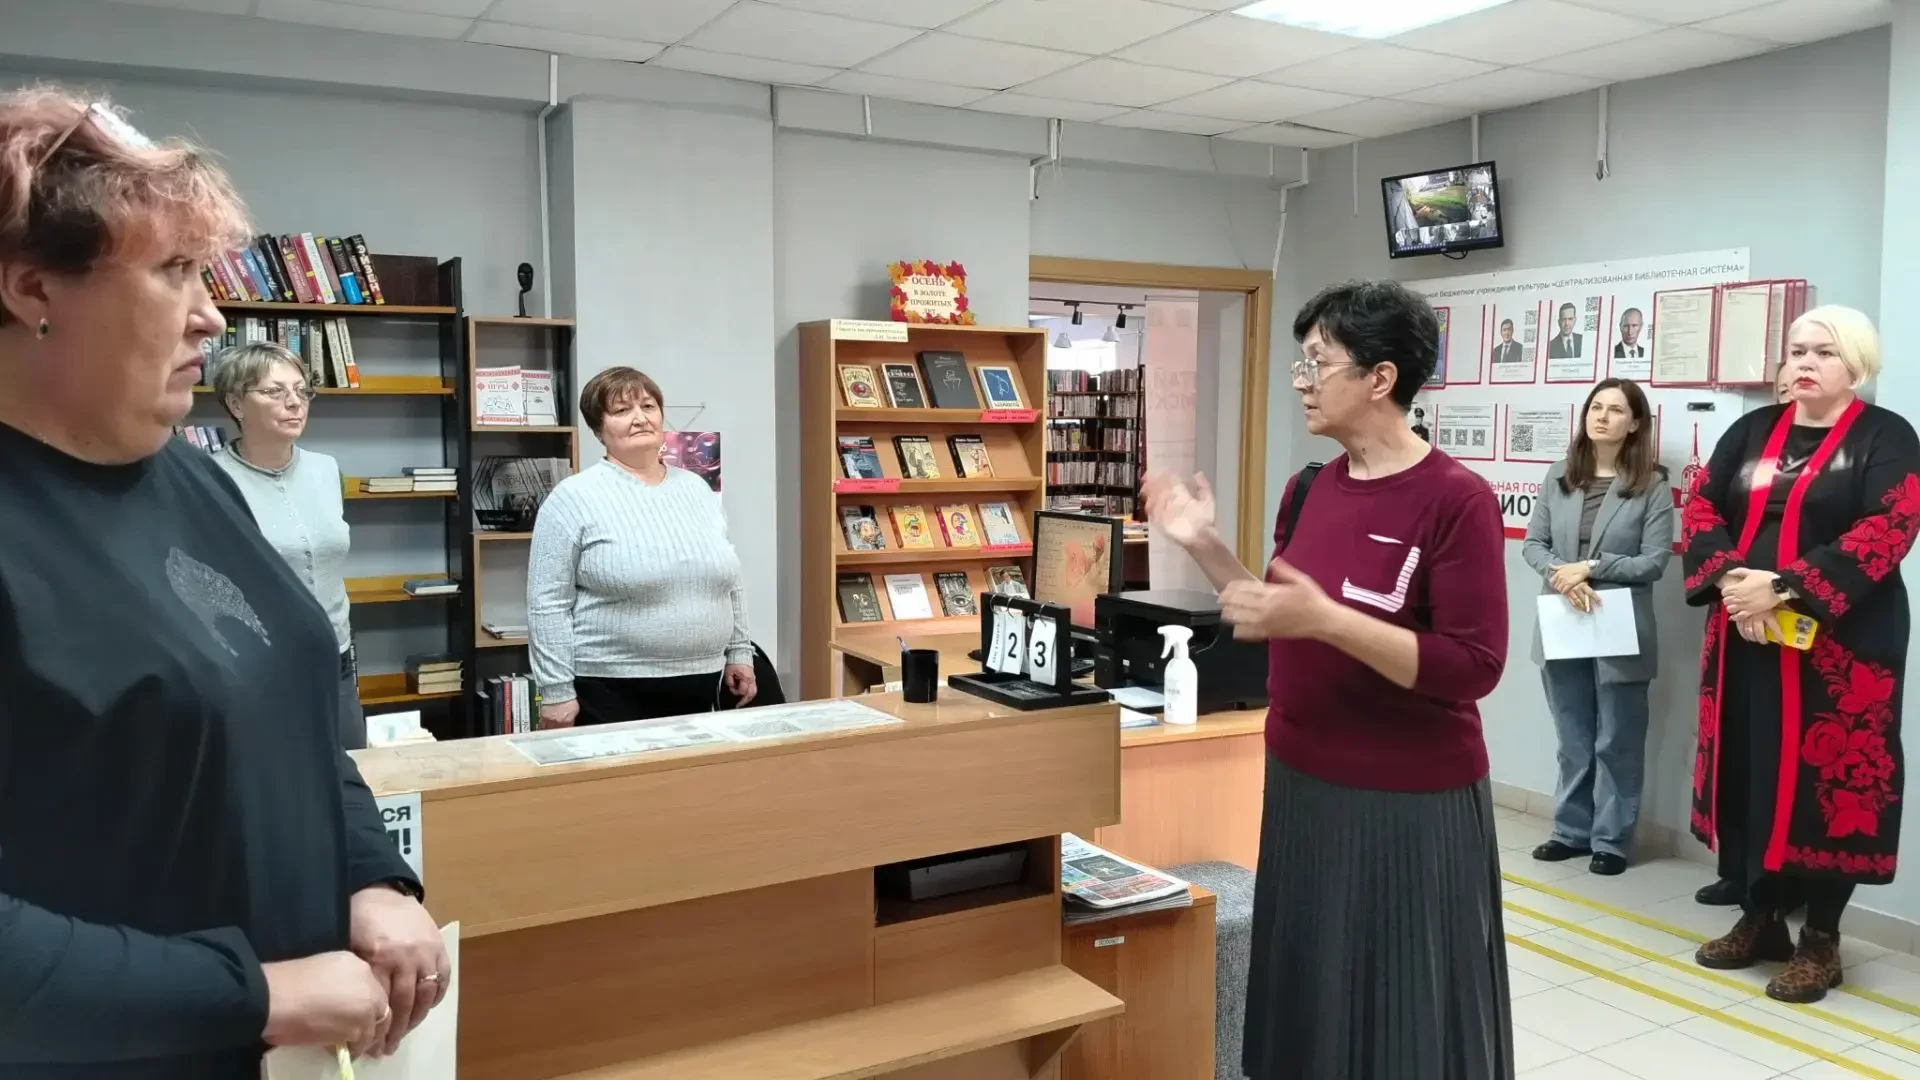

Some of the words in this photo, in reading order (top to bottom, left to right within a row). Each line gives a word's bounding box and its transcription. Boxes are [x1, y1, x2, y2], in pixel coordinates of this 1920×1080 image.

[912, 277, 946, 287] ОСЕНЬ
[1439, 289, 1475, 298] бюджетное
[1475, 284, 1516, 296] учреждение
[1517, 282, 1550, 292] культуры
[1551, 273, 1633, 288] «ЦЕНТРАЛИЗОВАННАЯ
[1634, 268, 1698, 281] БИБЛИОТЕЧНАЯ
[1699, 264, 1745, 275] СИСТЕМА»
[910, 299, 952, 307] ПРОЖИТЫХ
[1490, 481, 1519, 493] ЬНАЯ
[1007, 632, 1018, 659] 2
[1033, 640, 1046, 668] 3
[381, 805, 412, 823] СЯ
